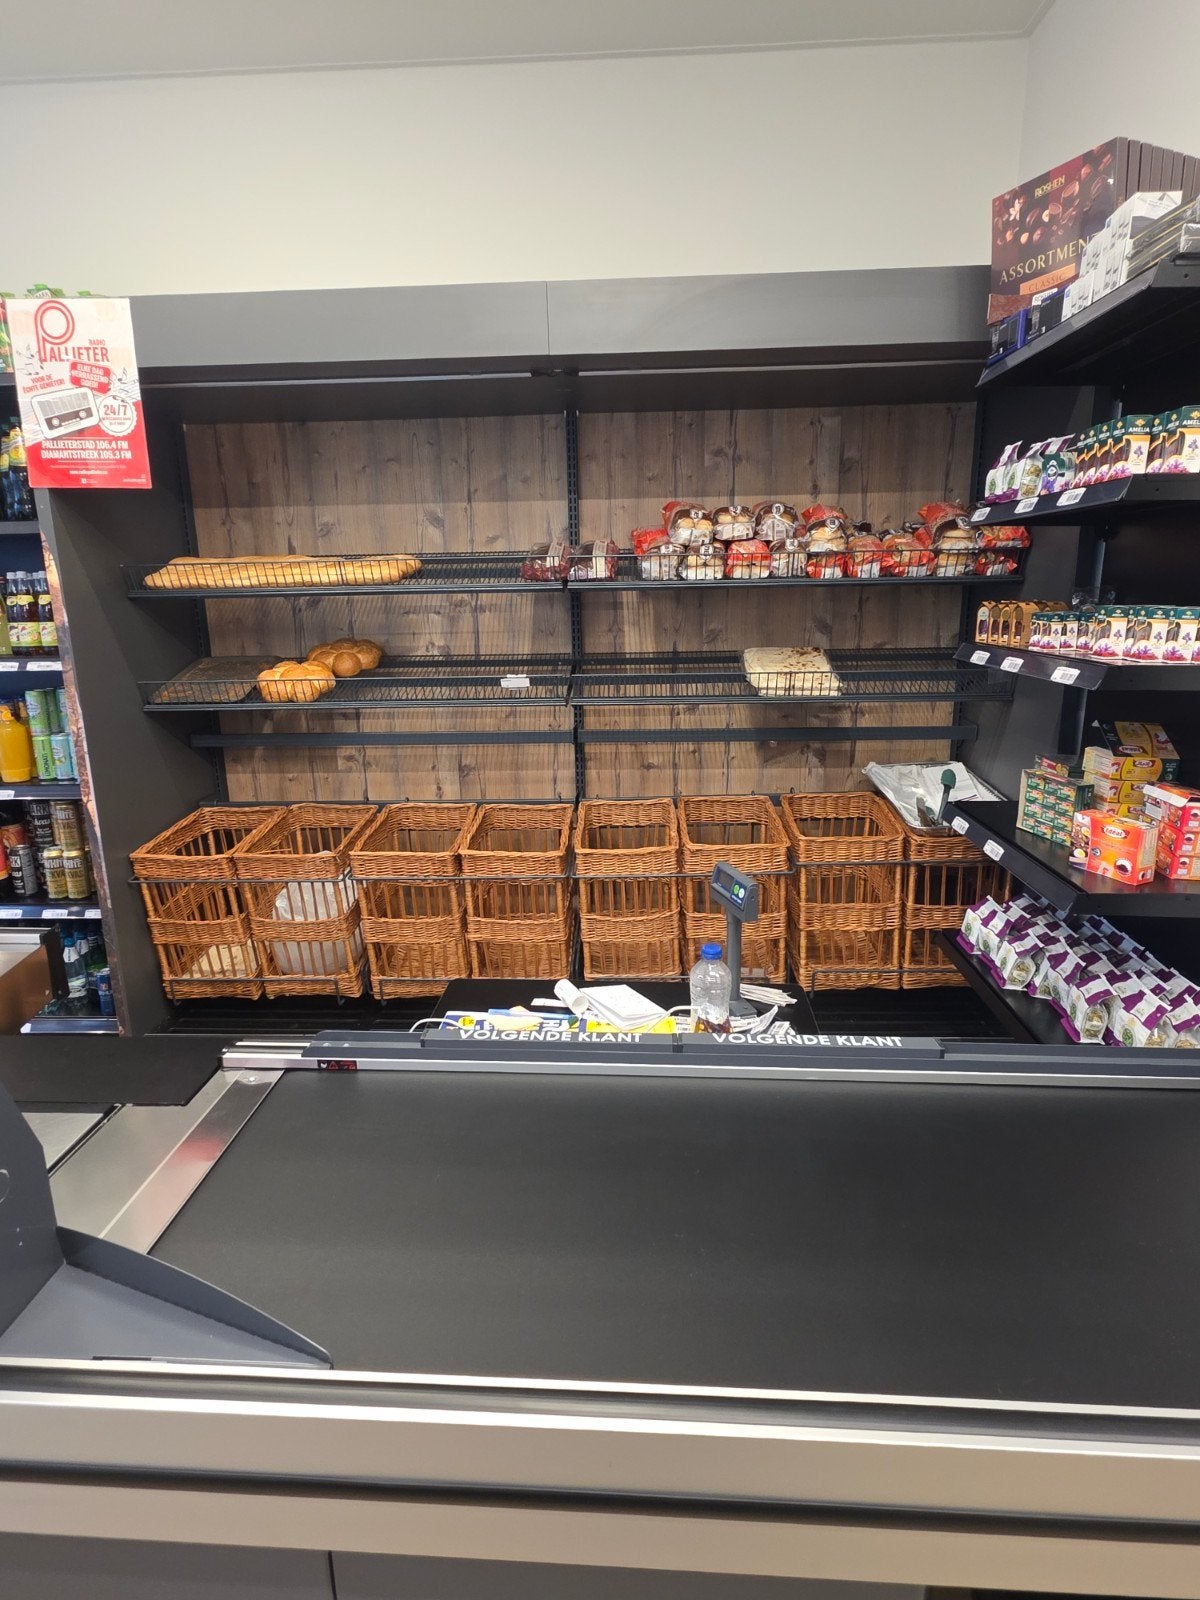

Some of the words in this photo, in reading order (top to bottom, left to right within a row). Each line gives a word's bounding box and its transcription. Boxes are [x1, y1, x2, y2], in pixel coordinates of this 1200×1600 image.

[1034, 175, 1066, 199] ROSHEN
[999, 233, 1097, 285] ASSORTMEN
[1027, 273, 1067, 293] CLASSIC
[103, 405, 128, 416] 24/7
[41, 440, 95, 450] PALLIETERSTAD
[96, 440, 117, 450] 106.4
[117, 440, 129, 450] FM
[41, 450, 99, 459] DIAMANTSTREEK
[99, 450, 120, 459] 105.3
[121, 451, 132, 460] FM
[44, 859, 64, 869] WHIT
[459, 1029, 571, 1042] VOLGENDE
[578, 1031, 642, 1043] KLANT
[713, 1033, 831, 1046] VOLGENDE
[836, 1036, 902, 1048] KLANT
